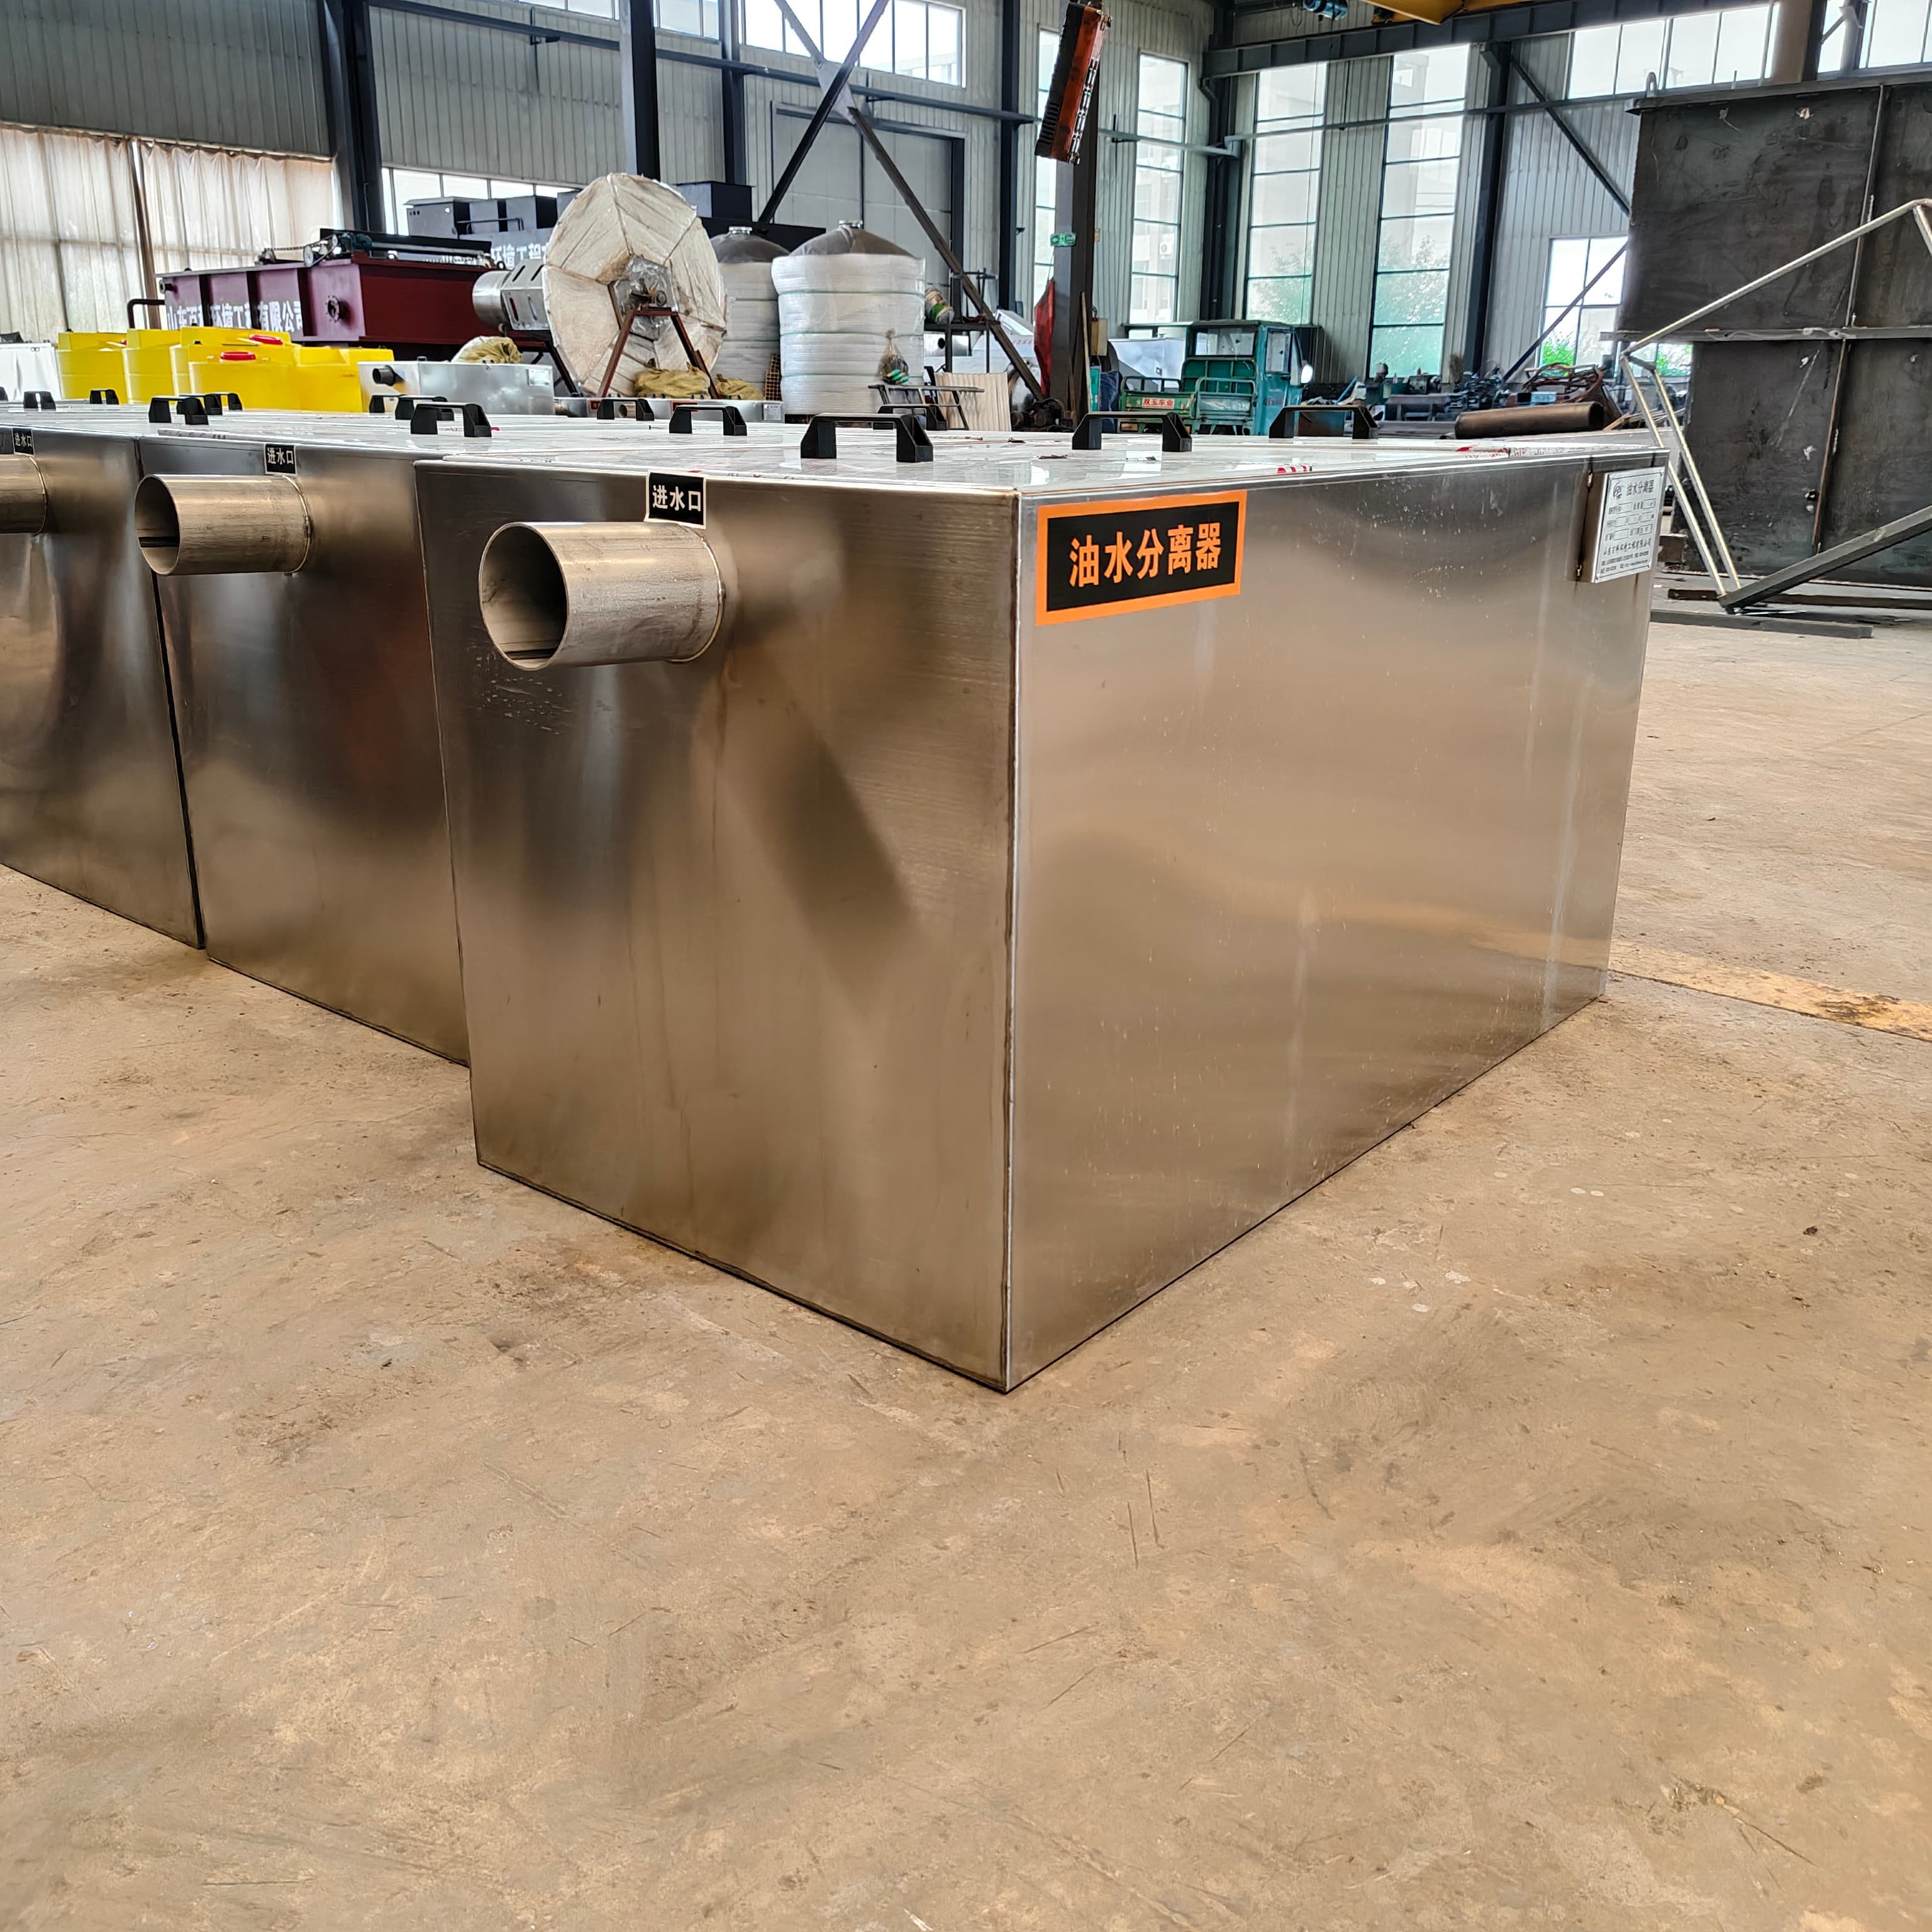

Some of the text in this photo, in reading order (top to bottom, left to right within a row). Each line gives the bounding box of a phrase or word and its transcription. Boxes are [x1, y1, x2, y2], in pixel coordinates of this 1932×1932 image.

[14, 432, 33, 447] 进水口
[267, 447, 294, 465] 进水口
[652, 484, 701, 512] 进水口
[1069, 521, 1221, 588] 油水分离器
